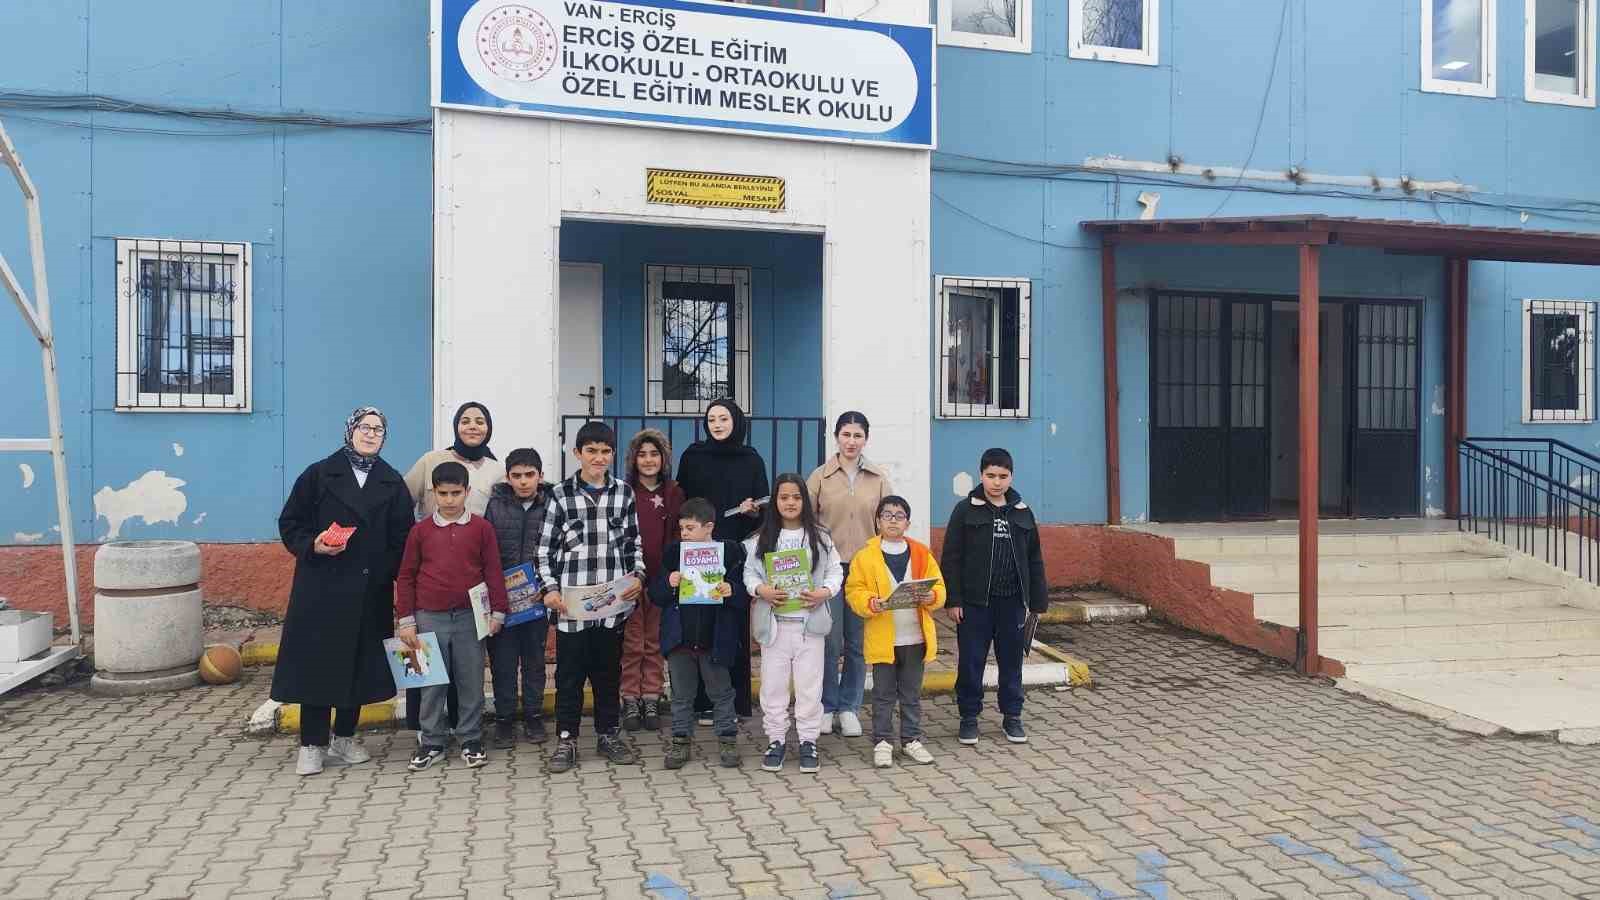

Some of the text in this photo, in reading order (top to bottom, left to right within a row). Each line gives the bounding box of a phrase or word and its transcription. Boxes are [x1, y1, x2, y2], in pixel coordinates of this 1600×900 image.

[564, 1, 602, 20] VAN
[620, 8, 676, 30] ERCİŞ
[563, 24, 635, 53] ERCİŞ
[642, 29, 705, 57] ÖZEL
[711, 38, 787, 65] EĞİTİM
[562, 45, 684, 79] İLKOKULU
[705, 64, 844, 94] ORTAOKULU
[851, 78, 879, 98] VE
[562, 71, 893, 122] ÖZEL EĞİTİM MESLEK OKULU
[655, 189, 688, 197] SOSYAL
